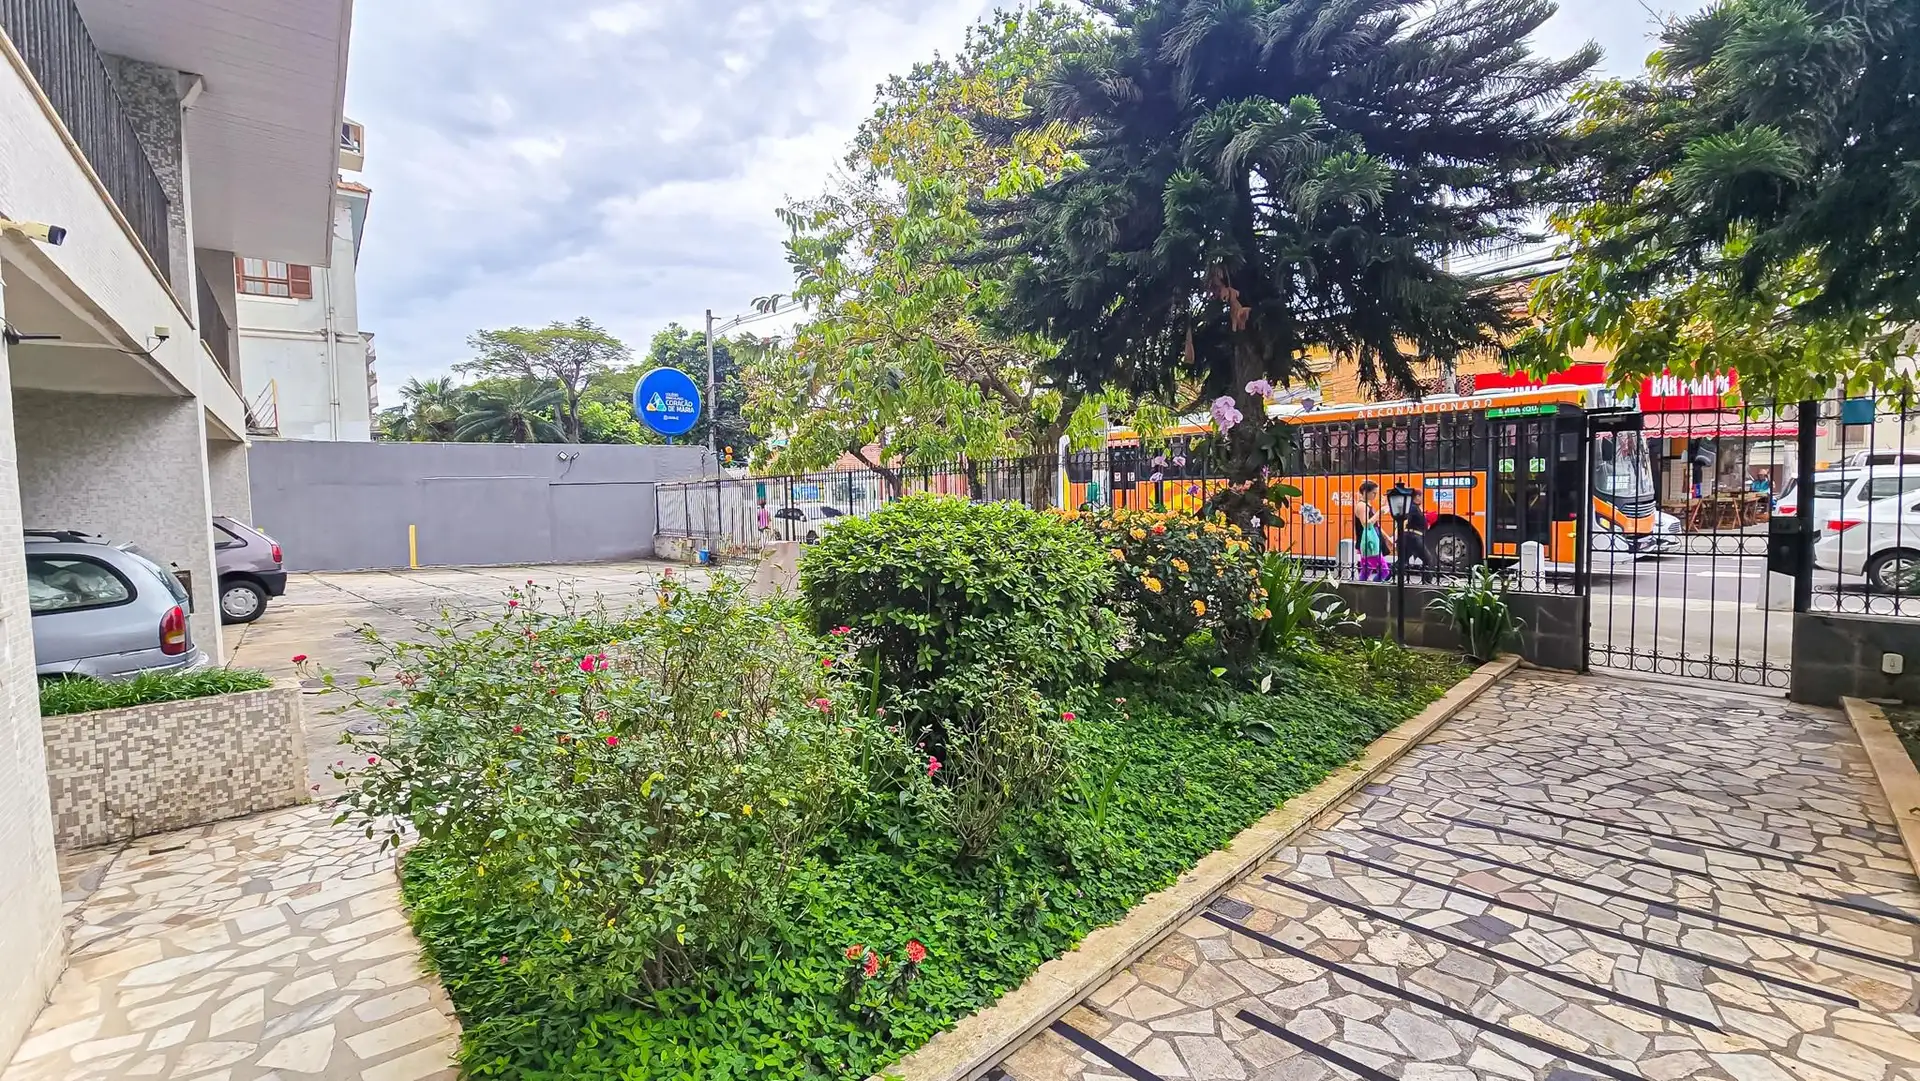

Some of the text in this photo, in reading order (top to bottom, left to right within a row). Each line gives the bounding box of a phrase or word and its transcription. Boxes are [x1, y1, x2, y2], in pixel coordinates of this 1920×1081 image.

[1651, 374, 1678, 397] BAR
[665, 399, 694, 407] CORAÇÃO
[1377, 399, 1493, 417] CONDICIONADO
